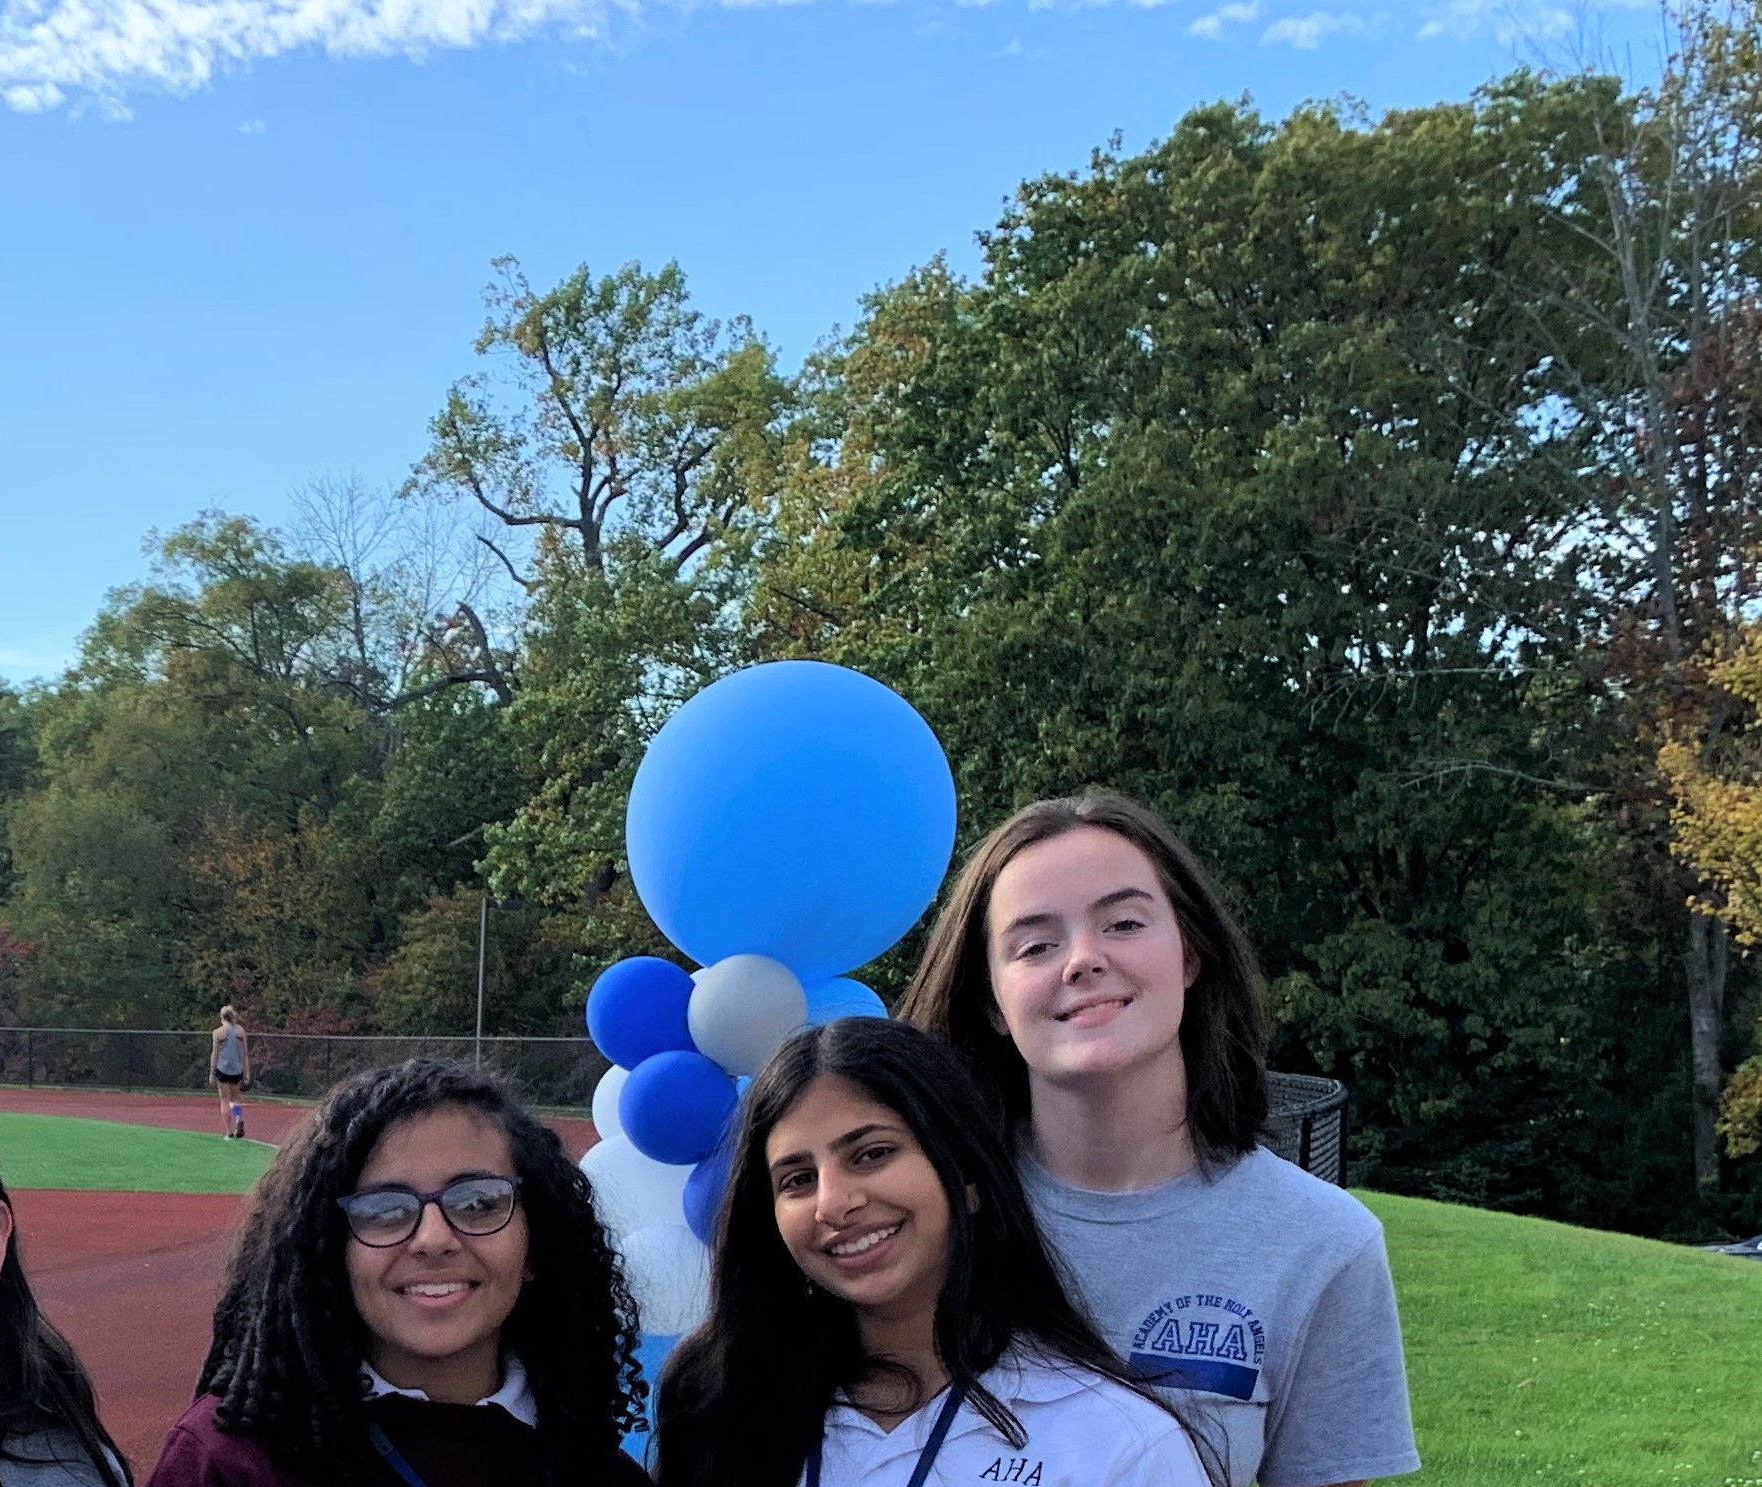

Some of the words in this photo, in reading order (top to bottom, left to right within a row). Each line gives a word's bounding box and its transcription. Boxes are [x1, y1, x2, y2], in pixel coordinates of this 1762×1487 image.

[1132, 1302, 1174, 1349] ACADEMY
[1175, 1295, 1191, 1309] OF
[1197, 1294, 1223, 1307] THE
[1223, 1299, 1254, 1319] HOLY
[1247, 1319, 1265, 1365] ANGELS
[1152, 1318, 1247, 1361] AHA
[978, 1457, 1043, 1487] AHA
